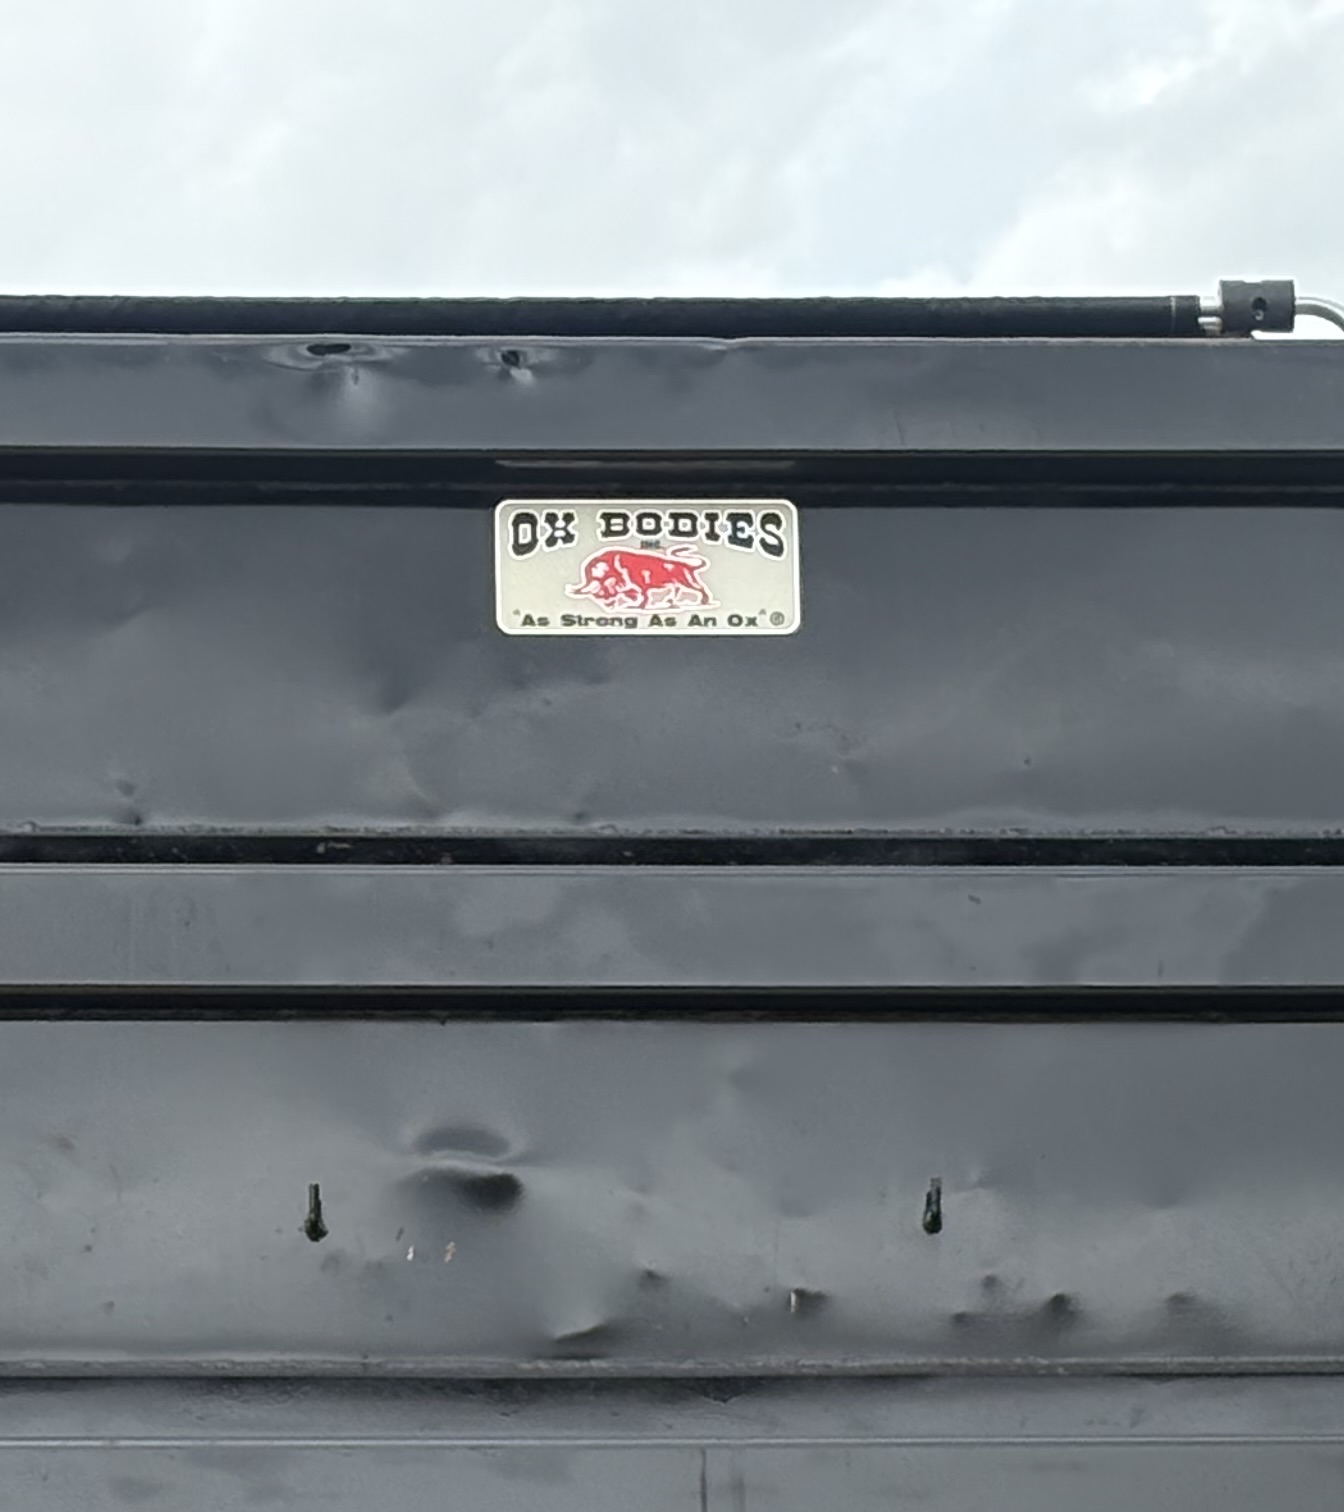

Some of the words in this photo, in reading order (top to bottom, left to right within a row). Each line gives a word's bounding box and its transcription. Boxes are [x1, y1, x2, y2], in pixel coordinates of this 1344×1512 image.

[510, 511, 576, 557] OX
[598, 510, 786, 558] BODIES
[560, 614, 638, 629] Strong
[648, 614, 677, 627] As
[687, 614, 718, 627] An
